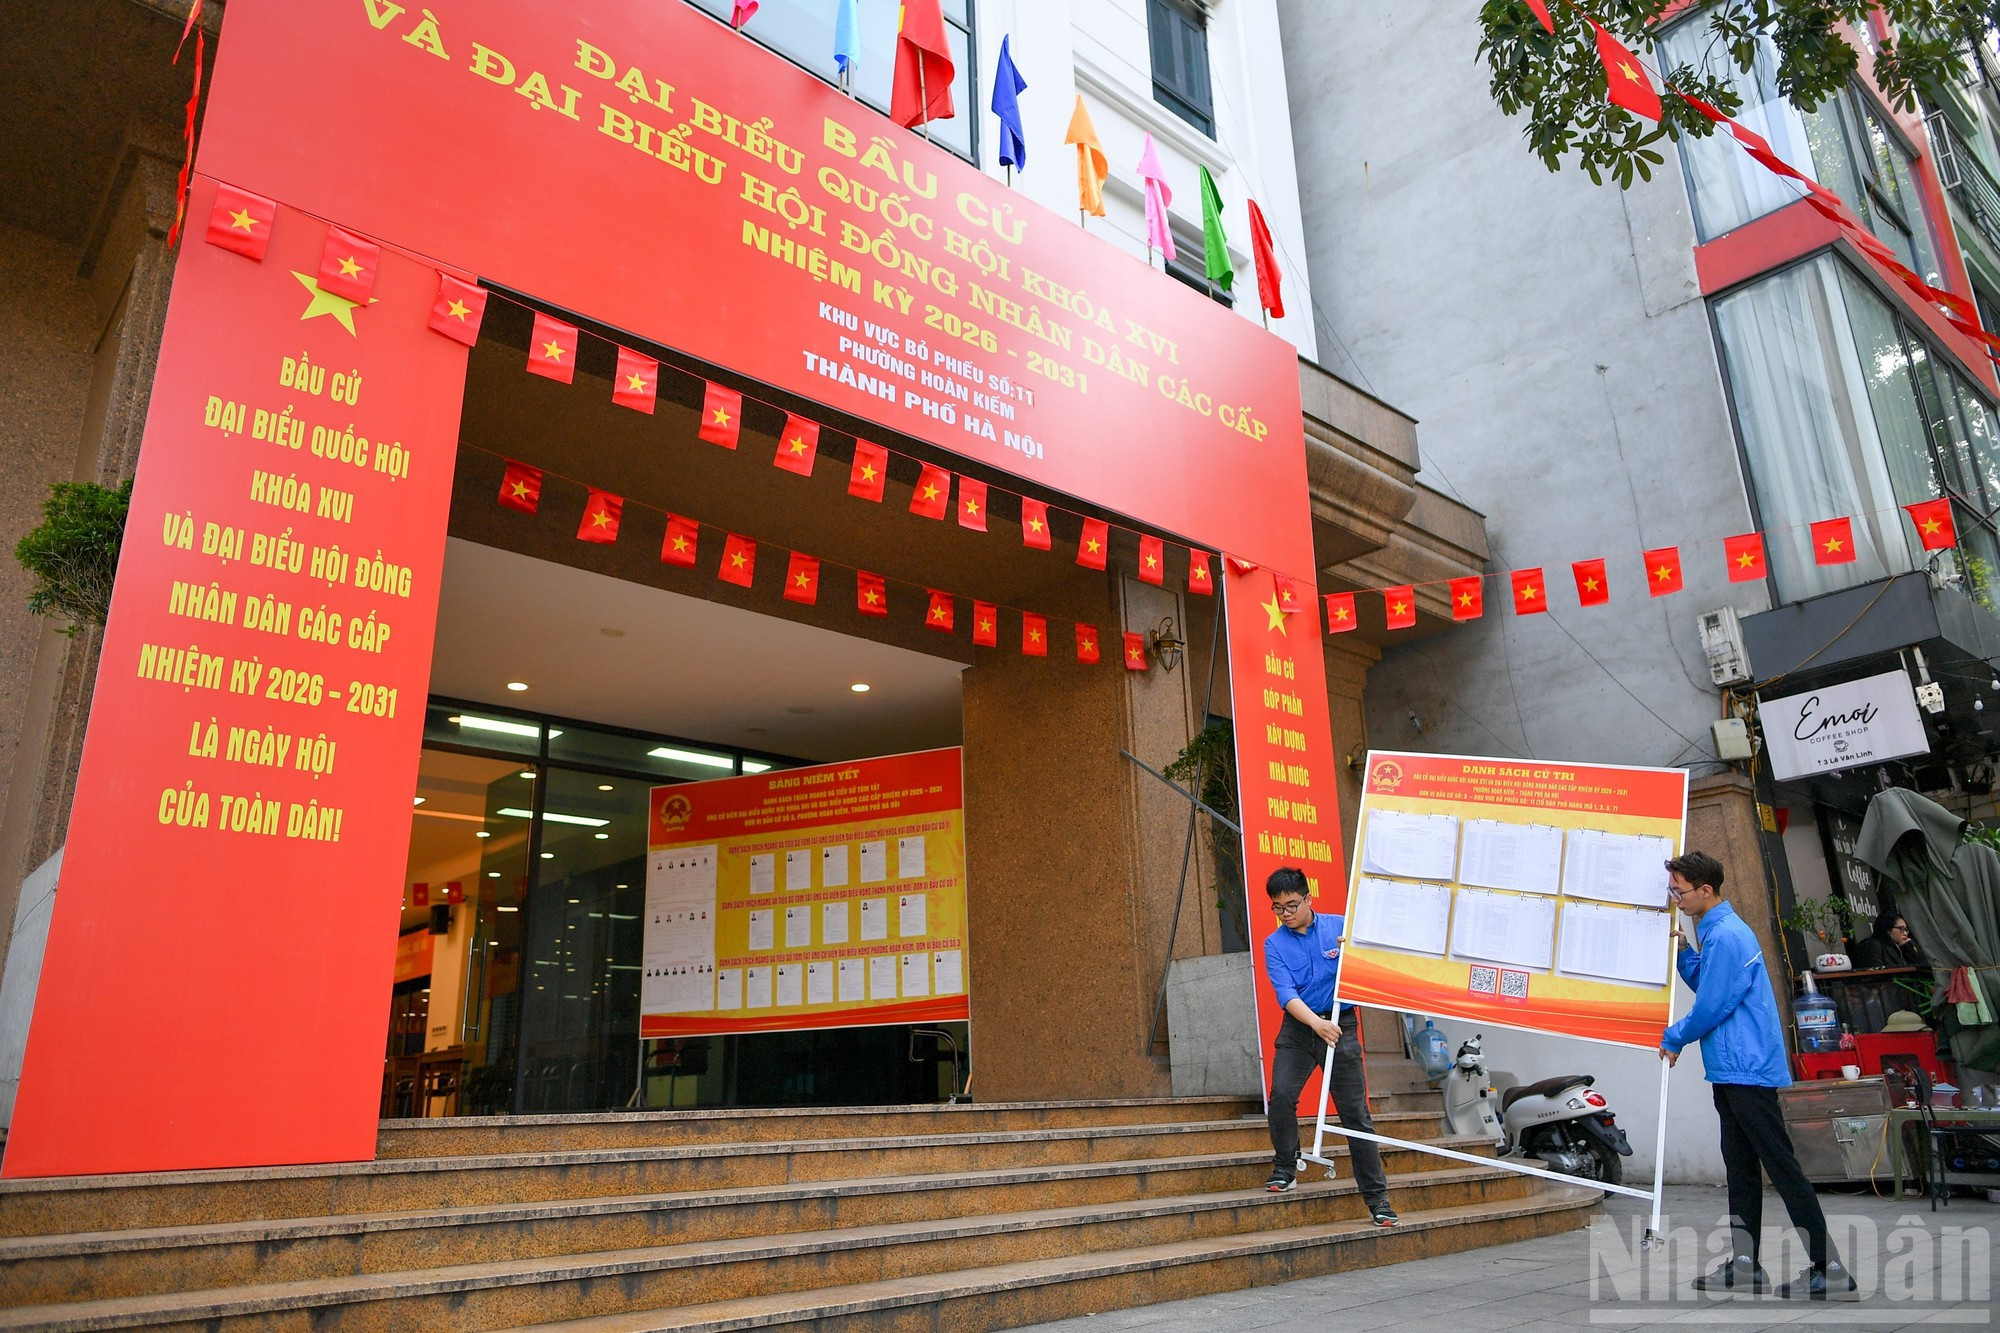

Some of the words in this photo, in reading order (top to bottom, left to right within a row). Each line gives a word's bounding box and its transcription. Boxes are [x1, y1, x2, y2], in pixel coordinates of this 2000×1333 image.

[575, 39, 675, 113] ĐẠI
[689, 97, 805, 175] BIỂU
[818, 166, 932, 240] QUỐC
[944, 226, 1011, 282] HỘI
[1020, 265, 1115, 332] KHÓA
[1124, 318, 1180, 365] XVI
[823, 116, 938, 200] BẦU
[957, 191, 1029, 245] CỬ
[363, 0, 450, 61] VÀ
[469, 42, 582, 121] ĐẠI
[598, 103, 727, 184] BIỂU
[740, 171, 827, 237] HỘI
[840, 220, 958, 296] ĐỒNG
[969, 280, 1072, 350] NHÂN
[1082, 338, 1149, 388] DÂN
[1157, 372, 1212, 417] CÁC
[1218, 403, 1269, 443] CẤP
[742, 219, 861, 294] NHIỆM
[873, 278, 914, 316] KỲ
[925, 305, 997, 352] 2026
[1027, 351, 1089, 395] 2031
[819, 302, 857, 331] KHU
[864, 321, 899, 348] VỰC
[906, 338, 928, 360] BỎ
[935, 351, 983, 383] PHIẾU
[280, 352, 325, 395] BẦU
[331, 369, 362, 406] CỬ
[803, 351, 895, 402] THÀNH
[905, 391, 955, 424] PHỐ
[965, 414, 996, 441] HÀ
[1004, 430, 1044, 460] NỘI
[840, 336, 915, 380] PHƯỜNG
[922, 370, 968, 401] HOÀN
[974, 391, 1014, 419] KIẾM
[204, 396, 246, 436] ĐẠI
[252, 404, 305, 449] BIỂU
[311, 423, 368, 467] QUỐC
[374, 442, 410, 482] HỘI
[250, 470, 310, 513] KHÓA
[317, 487, 354, 523] XVI
[163, 512, 194, 550] VÀ
[202, 522, 244, 565] ĐẠI
[250, 527, 304, 573] BIỂU
[310, 545, 349, 588] HỘI
[355, 549, 412, 598] ĐỒNG
[169, 581, 237, 625] NHÂN
[243, 593, 292, 635] DÂN
[298, 604, 342, 645] CÁC
[348, 609, 390, 653] CẤP
[137, 644, 224, 692] NHIỆM
[230, 656, 263, 695] KỲ
[265, 667, 324, 706] 2026
[347, 681, 397, 719] 2031
[1265, 650, 1282, 676] BẦU
[1283, 657, 1294, 680] CỬ
[1264, 688, 1280, 710] GÓP
[1281, 690, 1303, 716] PHẦN
[189, 717, 218, 758] LÀ
[226, 725, 291, 767] NGÀY
[295, 733, 336, 779] HỘI
[1266, 722, 1282, 746] XÂY
[1284, 729, 1306, 752] DỰNG
[1810, 732, 1843, 744] COFFEE
[1845, 726, 1868, 737] SHOP
[769, 777, 800, 790] BẢNG
[803, 772, 834, 785] NIÊM
[838, 767, 859, 780] YẾT
[1269, 760, 1286, 782] NHÀ
[1288, 764, 1309, 787] NƯỚC
[1462, 765, 1496, 775] DANH
[1499, 767, 1530, 777] SÁCH
[1533, 769, 1549, 779] CỬ
[1553, 772, 1575, 781] TRI
[159, 780, 209, 828] CỦA
[219, 792, 281, 835] TOÀN
[287, 799, 343, 842] DÂN!
[1268, 796, 1290, 819] PHÁP
[1291, 798, 1317, 824] QUYỀN
[1258, 830, 1270, 853] XÃ
[1272, 832, 1287, 859] HỘI
[1289, 834, 1306, 859] CHỦ
[1307, 840, 1332, 862] NGHĨA
